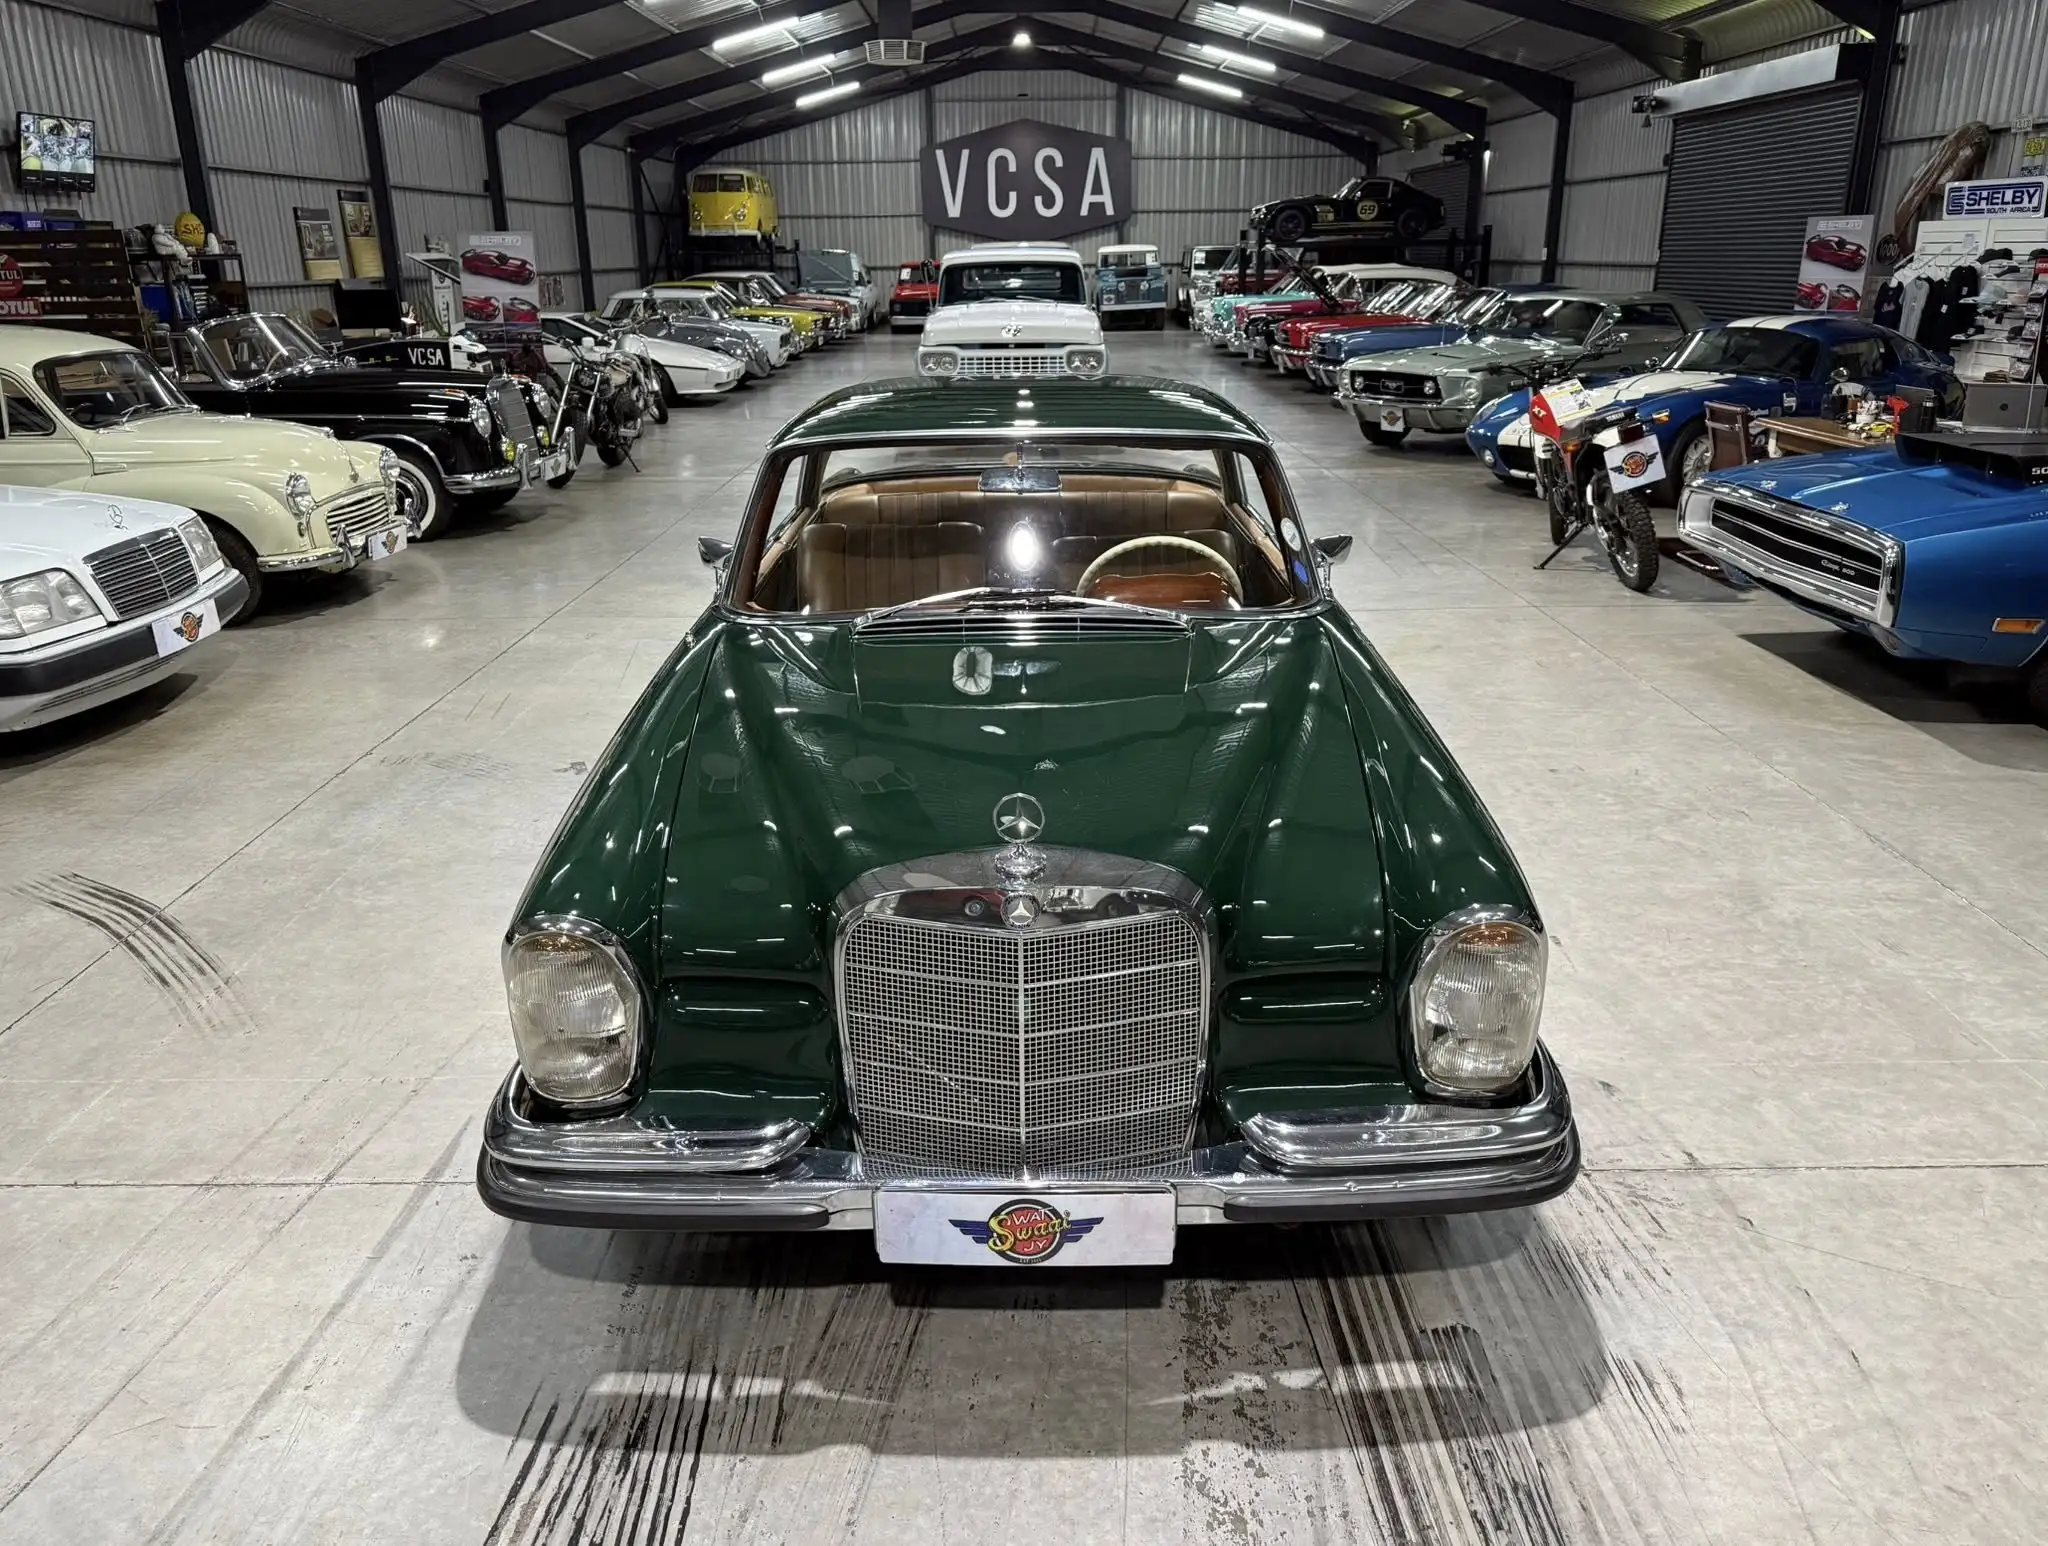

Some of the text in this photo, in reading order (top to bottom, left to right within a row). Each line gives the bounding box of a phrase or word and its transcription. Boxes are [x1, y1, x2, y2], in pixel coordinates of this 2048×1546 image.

[935, 147, 1115, 218] VCSA
[1965, 188, 2039, 207] SHELBY
[1360, 204, 1377, 215] 69
[0, 270, 20, 280] TUL
[0, 300, 39, 315] OTUL
[407, 347, 445, 366] VCSA
[1532, 404, 1547, 418] XT
[1012, 1206, 1055, 1226] WAT
[1023, 1239, 1047, 1252] JY
